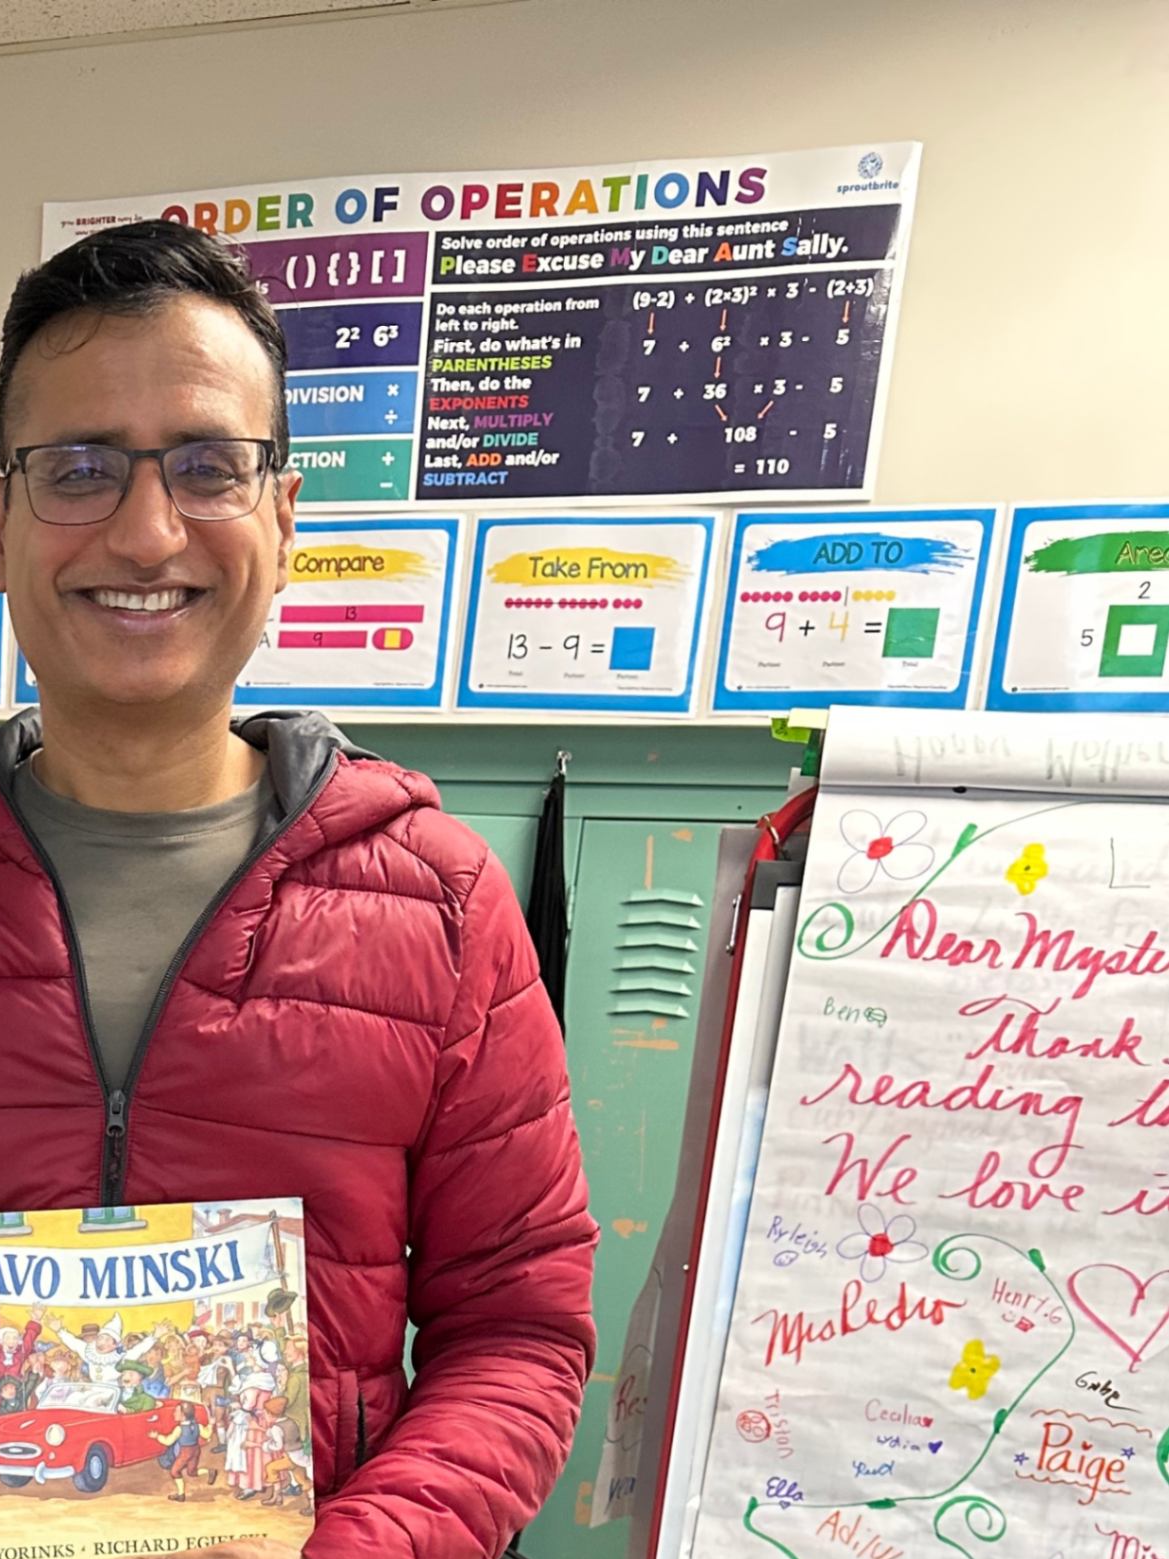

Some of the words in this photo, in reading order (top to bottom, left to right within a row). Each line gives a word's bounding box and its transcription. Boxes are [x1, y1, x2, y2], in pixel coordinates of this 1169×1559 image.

[837, 181, 899, 195] sproutbrite
[162, 192, 315, 237] ORDER
[335, 187, 400, 224] OF
[421, 167, 767, 222] OPERATIONS
[441, 237, 483, 250] Solve
[486, 235, 527, 249] order
[531, 234, 547, 248] of
[550, 229, 631, 249] operations
[635, 224, 679, 243] using
[682, 222, 713, 238] this
[717, 219, 789, 237] sentence
[440, 255, 516, 275] Please
[522, 251, 604, 273] Excuse
[611, 247, 646, 271] My
[652, 245, 709, 265] Dear
[714, 238, 775, 263] Aunt
[782, 233, 849, 259] Sally.
[436, 303, 455, 315] Do
[458, 302, 491, 315] each
[494, 299, 563, 317] operation
[565, 297, 600, 310] from
[435, 318, 461, 332] left
[463, 318, 478, 331] to
[481, 316, 519, 333] right.
[434, 338, 476, 354] First,
[479, 337, 501, 352] do
[505, 334, 561, 351] what's
[565, 333, 582, 348] in
[432, 355, 552, 373] PARENTHESES
[431, 377, 475, 392] Then,
[478, 376, 501, 390] do
[504, 375, 532, 390] the
[703, 383, 727, 400] 36
[430, 395, 530, 411] EXPONENTS
[428, 415, 471, 431] Next,
[474, 412, 554, 429] MULTIPLY
[426, 433, 480, 450] and/or
[483, 432, 539, 447] DIVIDE
[725, 426, 757, 443] 108
[424, 454, 463, 469] Last,
[465, 452, 503, 468] ADD
[505, 449, 560, 467] and/or
[756, 458, 789, 475] 110
[423, 470, 508, 487] SUBTRACT
[813, 542, 862, 565] ADD
[871, 541, 904, 565] TO
[293, 552, 385, 578] Compare
[529, 556, 581, 579] Take
[588, 556, 648, 580] From
[1138, 581, 1151, 600] 2
[765, 611, 786, 642] 9
[828, 610, 849, 641] 4
[508, 633, 529, 660] 13
[563, 634, 580, 660] 9
[1080, 629, 1094, 647] 5
[880, 898, 1003, 968] Dear
[824, 997, 859, 1025] Ben
[800, 1063, 1085, 1179] reading
[822, 1131, 919, 1205] We
[938, 1150, 1085, 1212] love
[79, 1239, 245, 1300] MINSKI
[1036, 1422, 1126, 1506] Paige
[766, 1476, 805, 1501] Ella
[93, 1537, 180, 1556] RICHARD
